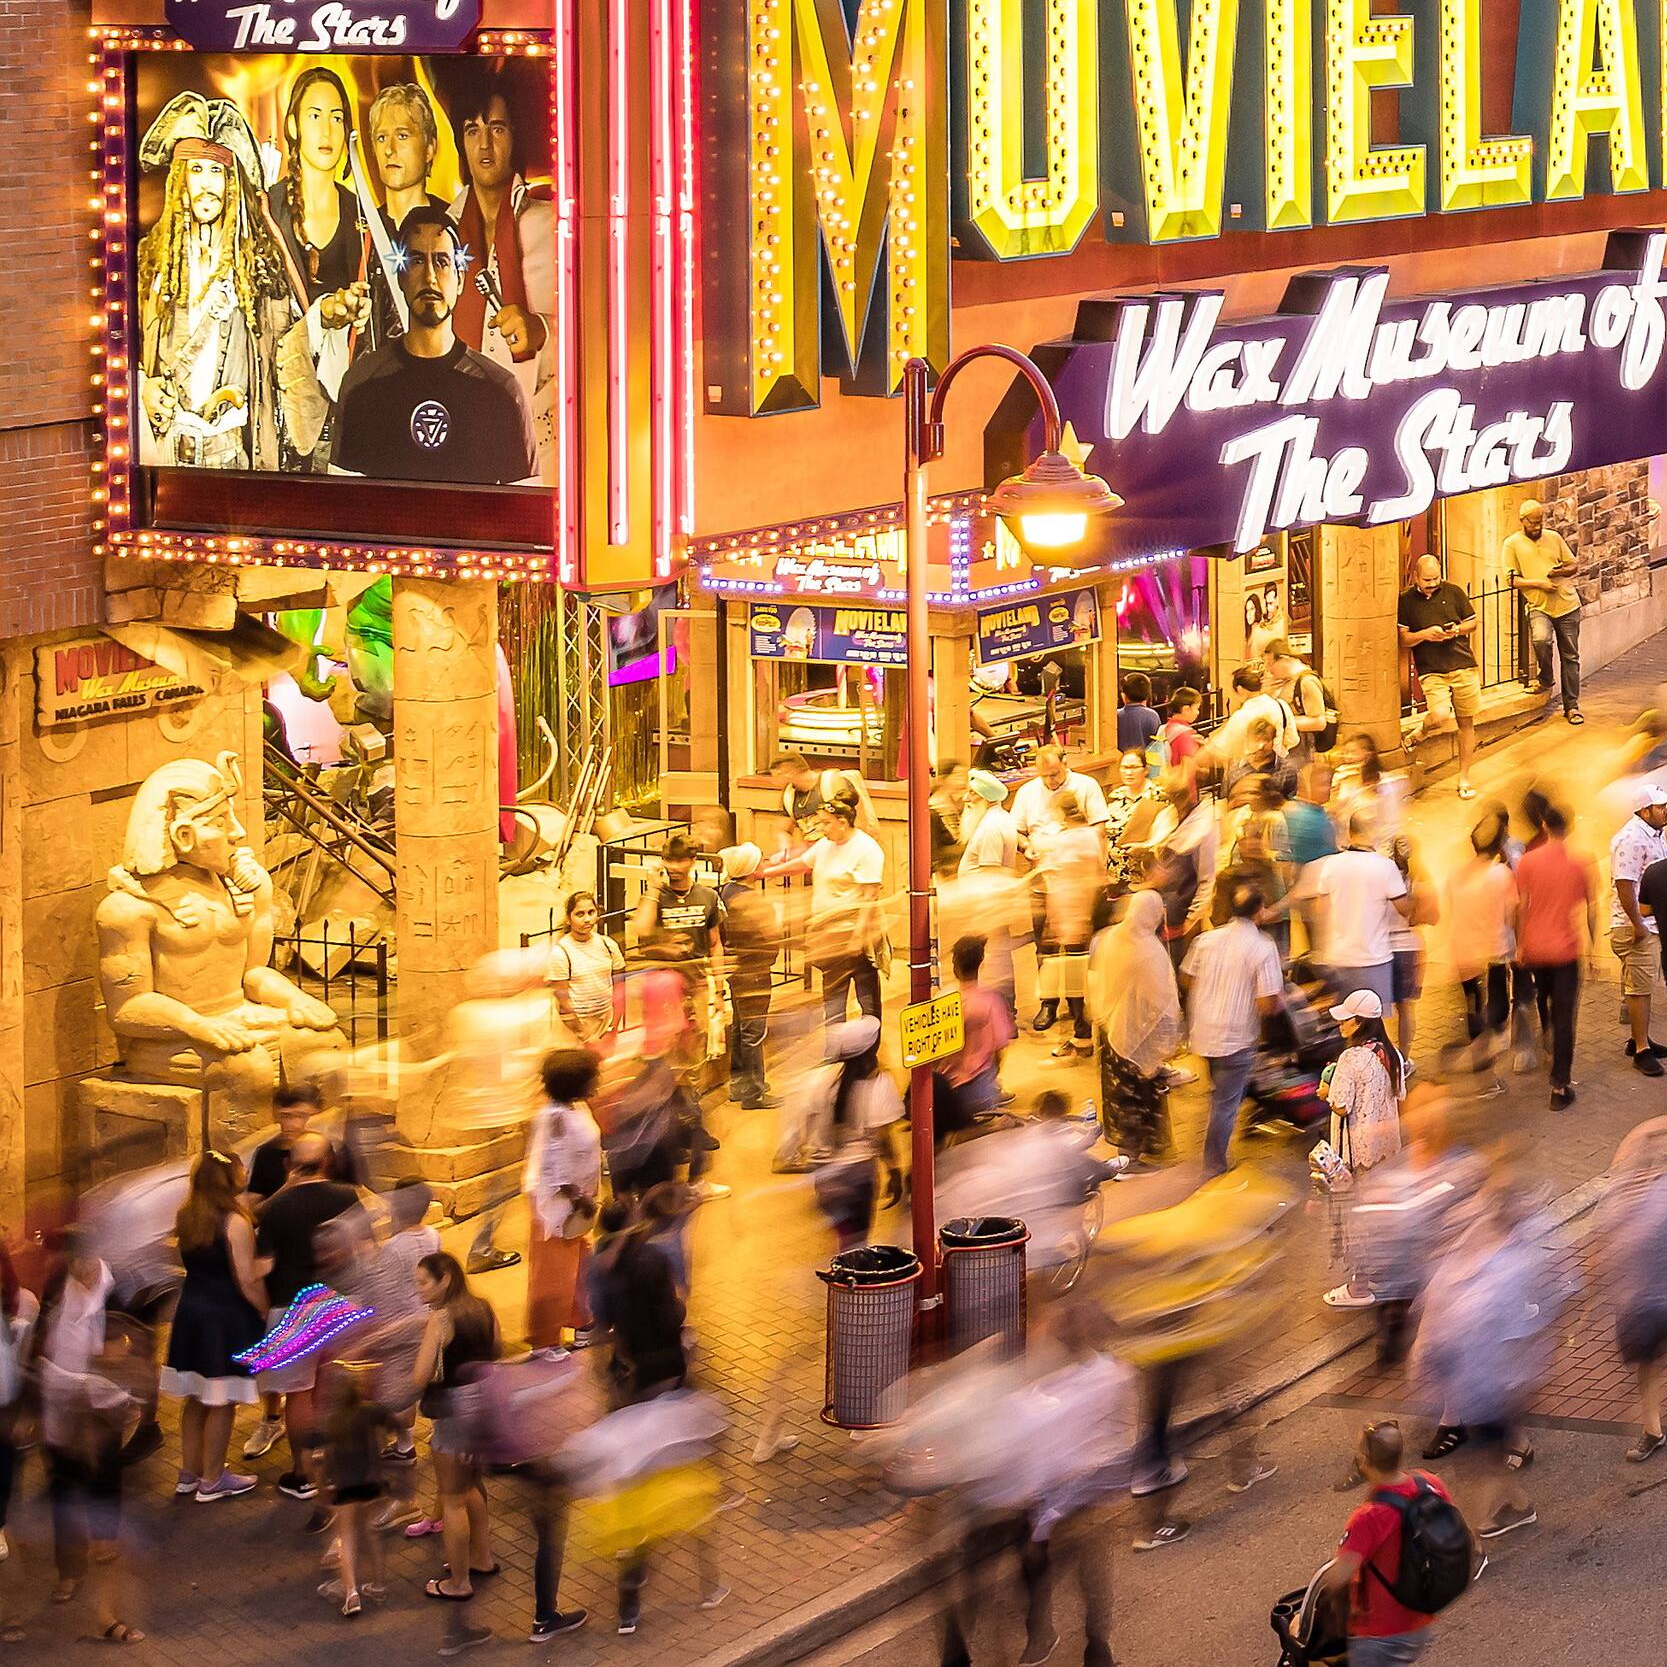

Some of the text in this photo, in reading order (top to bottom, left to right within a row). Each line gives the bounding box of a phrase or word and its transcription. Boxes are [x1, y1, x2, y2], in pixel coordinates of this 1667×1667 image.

[226, 2, 406, 51] The Stars
[1104, 292, 1283, 440] Wax
[1279, 266, 1588, 406] Museum
[1221, 390, 1575, 559] The Stars
[81, 678, 114, 701] Wax
[904, 1001, 960, 1033] VEHICLES HAVE
[908, 1025, 958, 1055] RIGHT OF WAY
